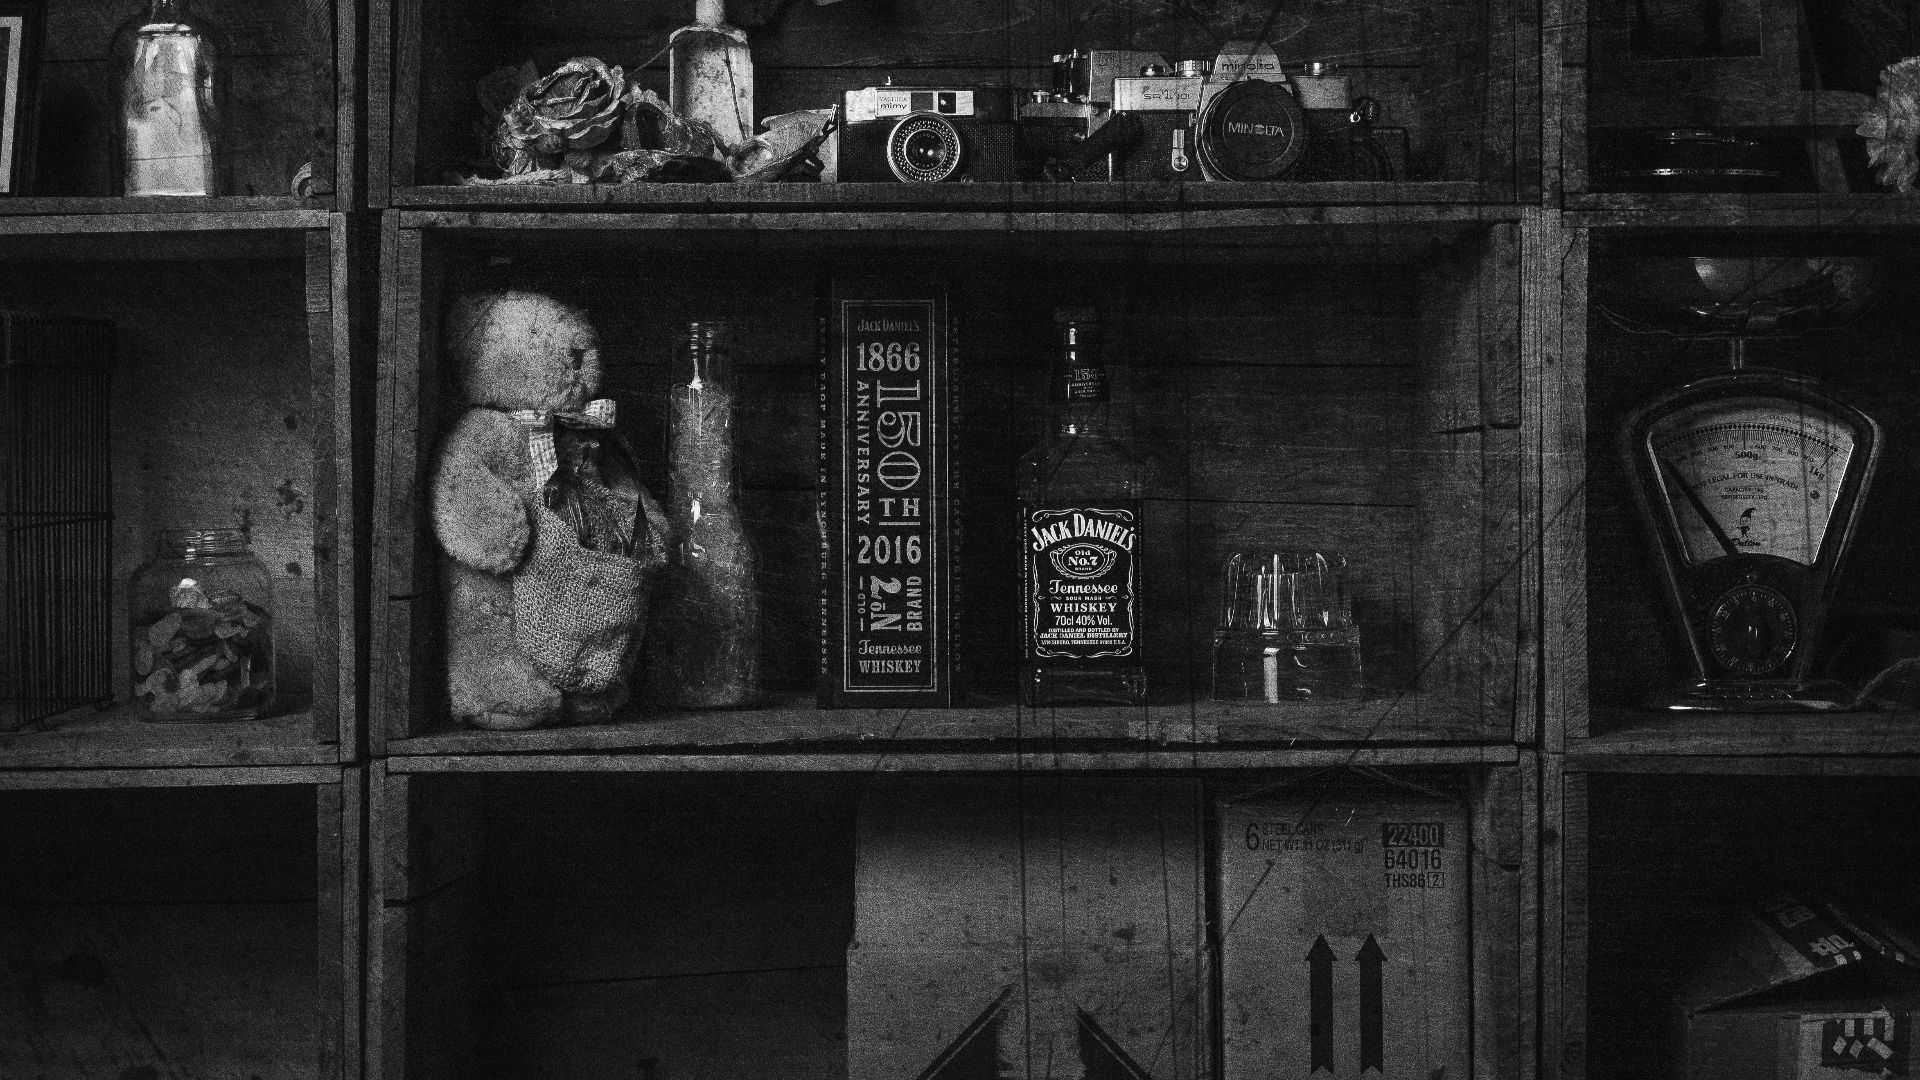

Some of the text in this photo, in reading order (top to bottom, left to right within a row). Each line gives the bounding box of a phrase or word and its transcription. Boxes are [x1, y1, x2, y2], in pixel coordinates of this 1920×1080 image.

[1222, 60, 1275, 71] minolta
[880, 102, 907, 110] mimy
[857, 319, 881, 332] JACK
[856, 342, 920, 372] 1866
[876, 380, 922, 491] 150
[856, 380, 870, 524] ANNIVERSARY
[1734, 452, 1759, 460] 500g
[820, 467, 827, 483] IN
[1808, 466, 1826, 480] 1kg
[1708, 474, 1732, 484] LEGAL
[1776, 477, 1800, 491] TRADE
[878, 497, 920, 517] TH
[1030, 513, 1137, 552] JACK DANIEL'S
[858, 535, 922, 564] 2016
[1068, 556, 1098, 567] No.7
[1049, 579, 1118, 594] Tennessee
[858, 592, 866, 614] OLD
[906, 576, 923, 632] BRAND
[1051, 602, 1117, 613] WHISKEY
[1055, 615, 1113, 626] 70cl 40% Vol.
[858, 640, 922, 654] Tennessee
[859, 659, 922, 674] WHISKEY
[1245, 822, 1260, 851] 6
[1262, 823, 1294, 835] STEEL
[1387, 825, 1440, 846] 22400
[1262, 839, 1282, 851] NET
[1316, 839, 1329, 851] OZ
[1384, 850, 1442, 870] 64016
[1385, 873, 1440, 888] THS86 2
